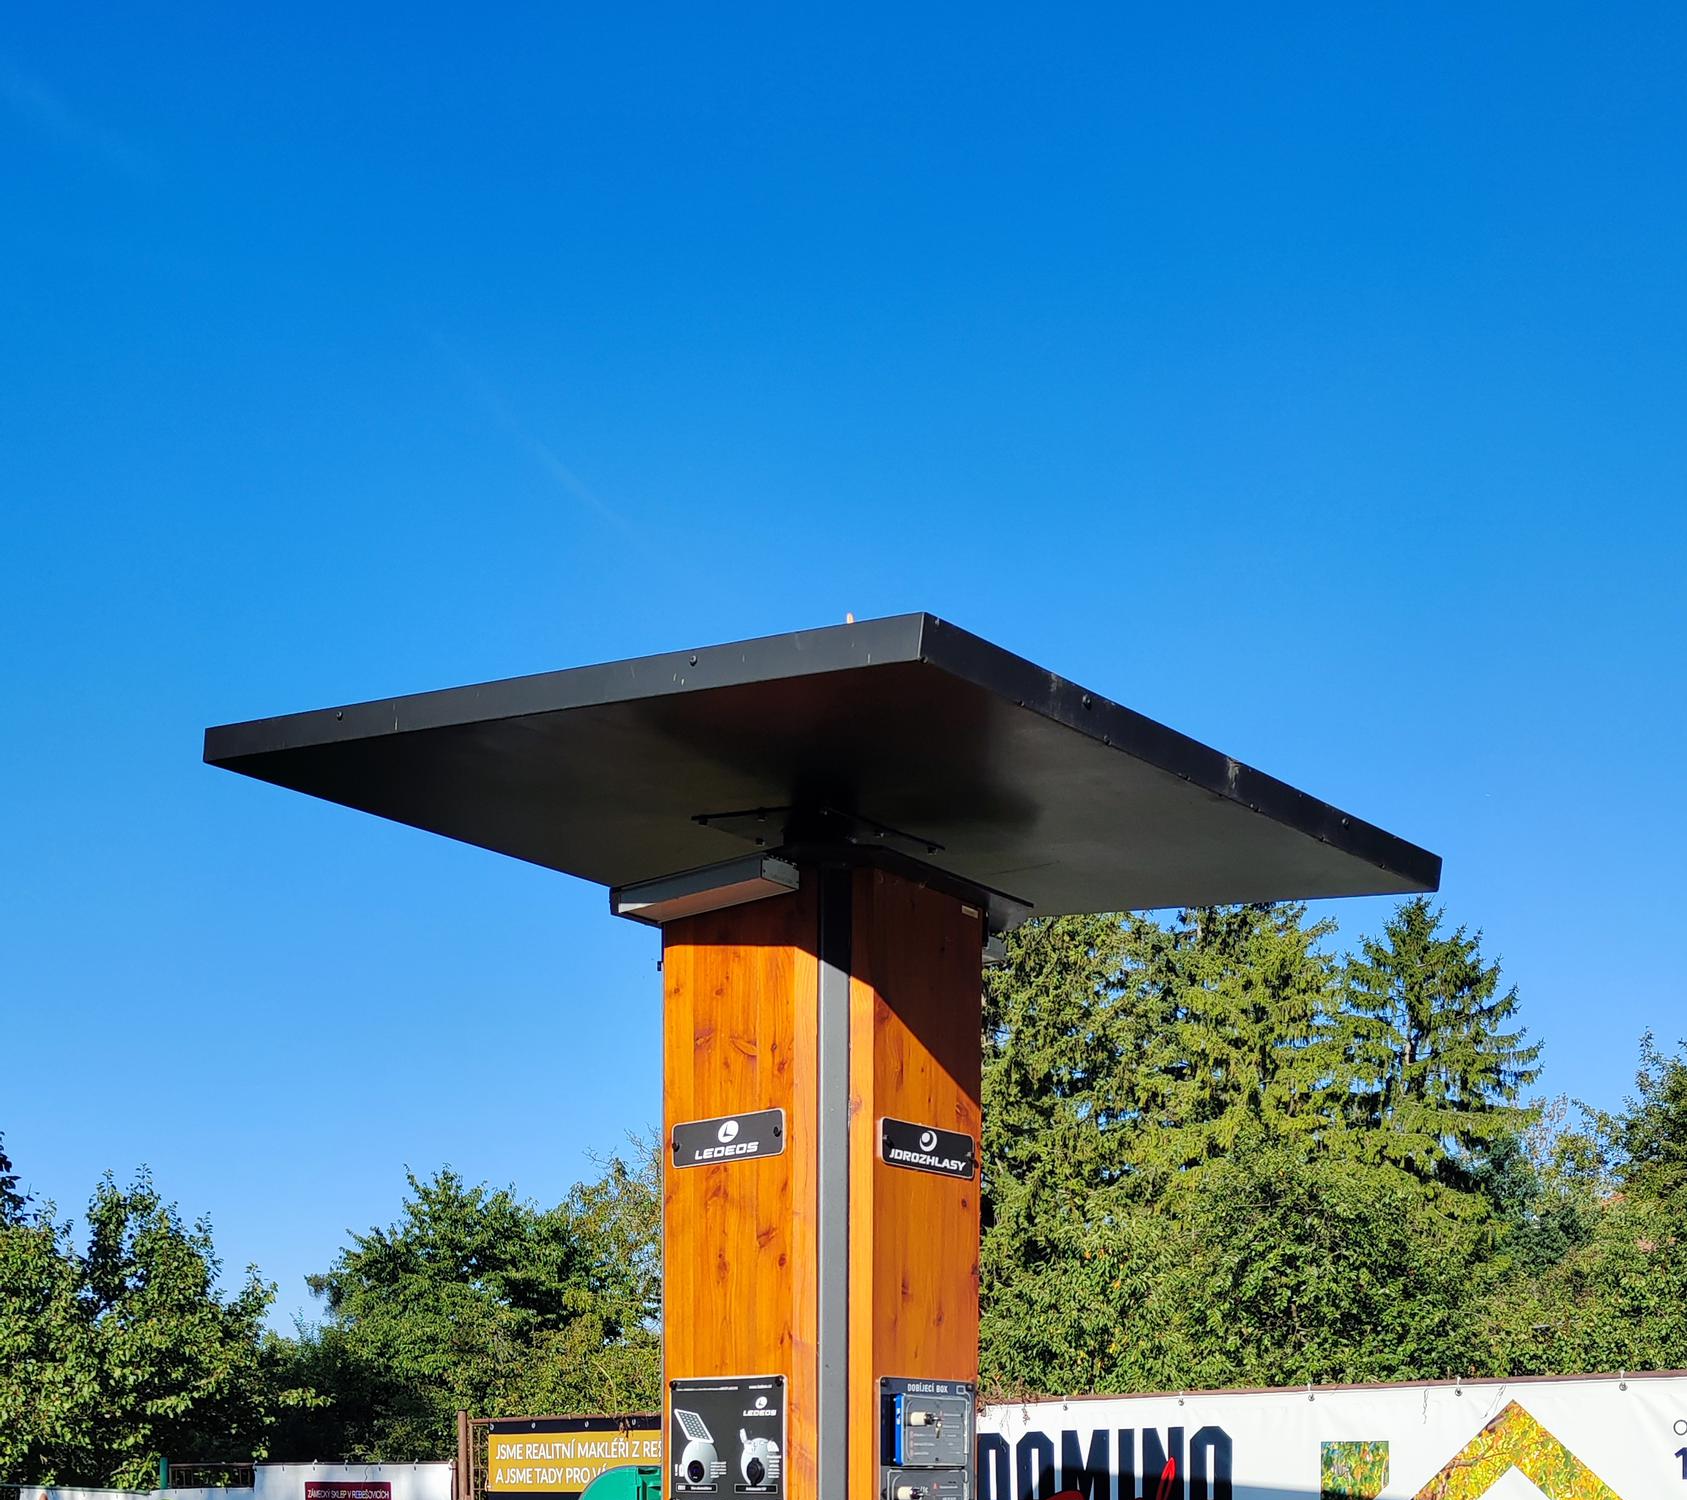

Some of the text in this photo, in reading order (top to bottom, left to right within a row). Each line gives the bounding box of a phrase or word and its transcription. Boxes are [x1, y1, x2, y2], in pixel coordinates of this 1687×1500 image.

[694, 1141, 759, 1160] LEDEOS
[936, 1385, 948, 1393] BOX
[496, 1444, 523, 1460] JSME
[526, 1439, 575, 1460] REALITNÍ
[578, 1438, 629, 1459] MAKLÉŘI
[632, 1441, 640, 1457] Z
[496, 1469, 504, 1483] A
[505, 1468, 532, 1484] JSME
[535, 1468, 562, 1483] TADY
[566, 1467, 590, 1483] PRO
